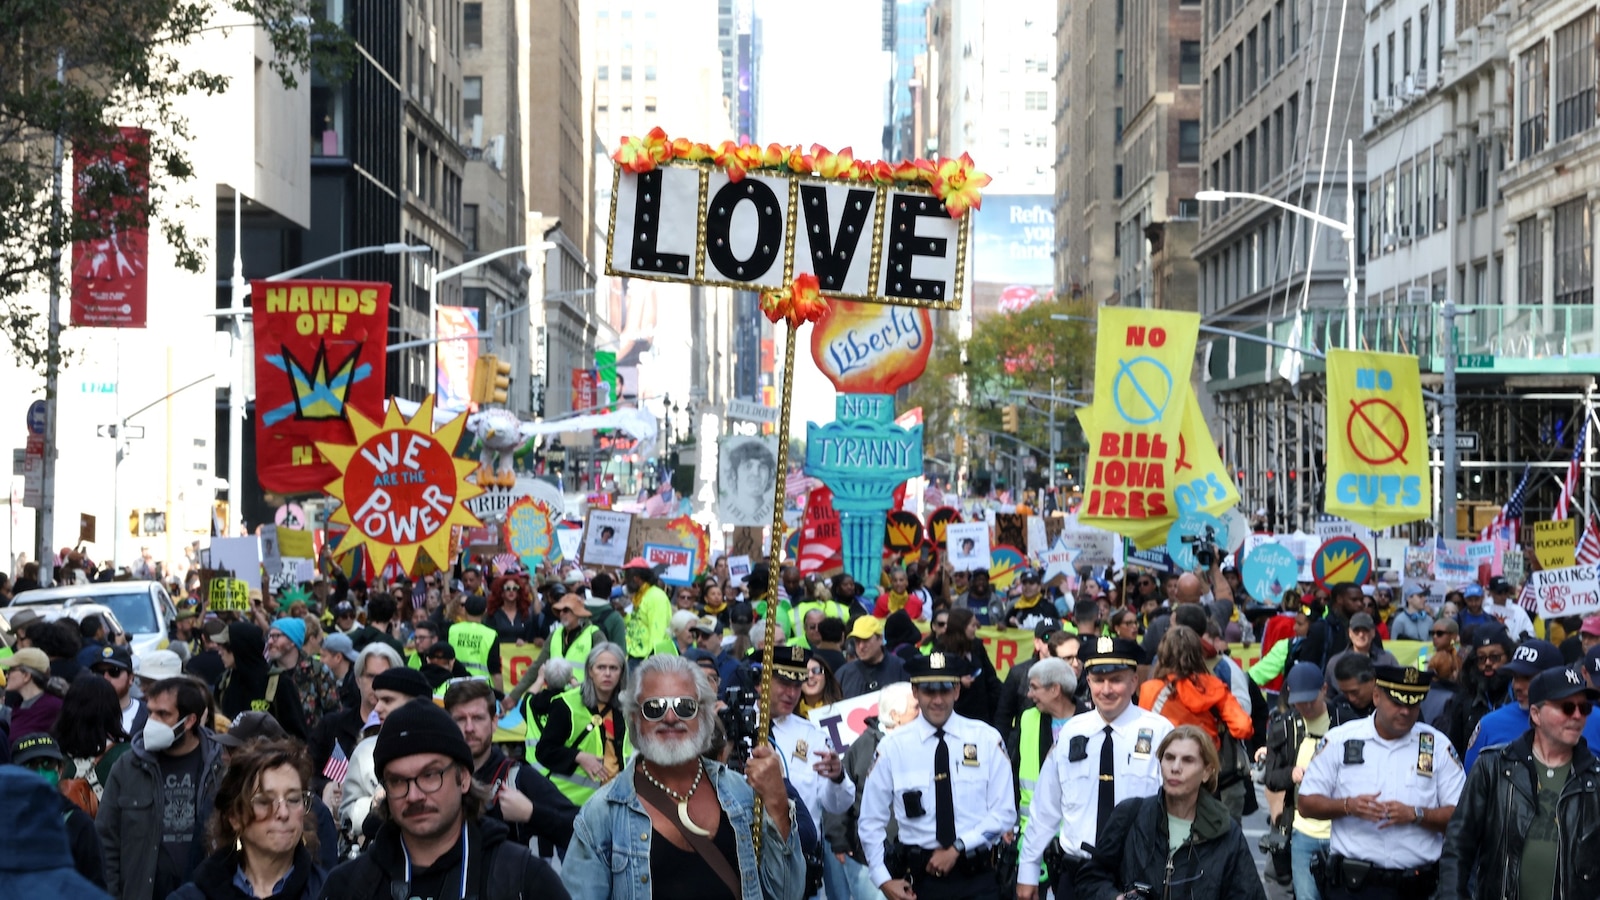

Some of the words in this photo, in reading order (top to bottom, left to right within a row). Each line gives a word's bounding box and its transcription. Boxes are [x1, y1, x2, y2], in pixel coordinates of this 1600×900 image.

[631, 169, 948, 300] LOVE
[266, 287, 378, 315] HANDS
[296, 314, 347, 336] OFF
[829, 306, 922, 376] Liberty
[1126, 326, 1167, 347] NO
[1356, 368, 1393, 392] NO
[843, 395, 882, 420] NOT
[360, 432, 431, 473] WE
[816, 438, 914, 470] TYRANNY
[1099, 432, 1168, 459] BILL
[374, 472, 398, 486] ARE
[403, 470, 425, 483] THE
[1093, 460, 1165, 489] IONA
[1336, 473, 1421, 506] CUTS
[353, 485, 453, 543] POWER
[1088, 490, 1168, 518] IRES
[817, 522, 837, 537] ARE
[1536, 523, 1557, 531] RULE
[1559, 522, 1569, 530] OF
[1467, 544, 1492, 556] RESIST
[1537, 538, 1574, 548] FUCKING
[1048, 552, 1070, 563] UNITE
[1134, 551, 1164, 563] JUSTICE
[1253, 548, 1291, 567] Justice
[1544, 557, 1564, 567] LAW
[1265, 567, 1275, 579] 4
[211, 579, 236, 590] ICE
[457, 640, 481, 648] RESIST
[819, 715, 849, 754] I
